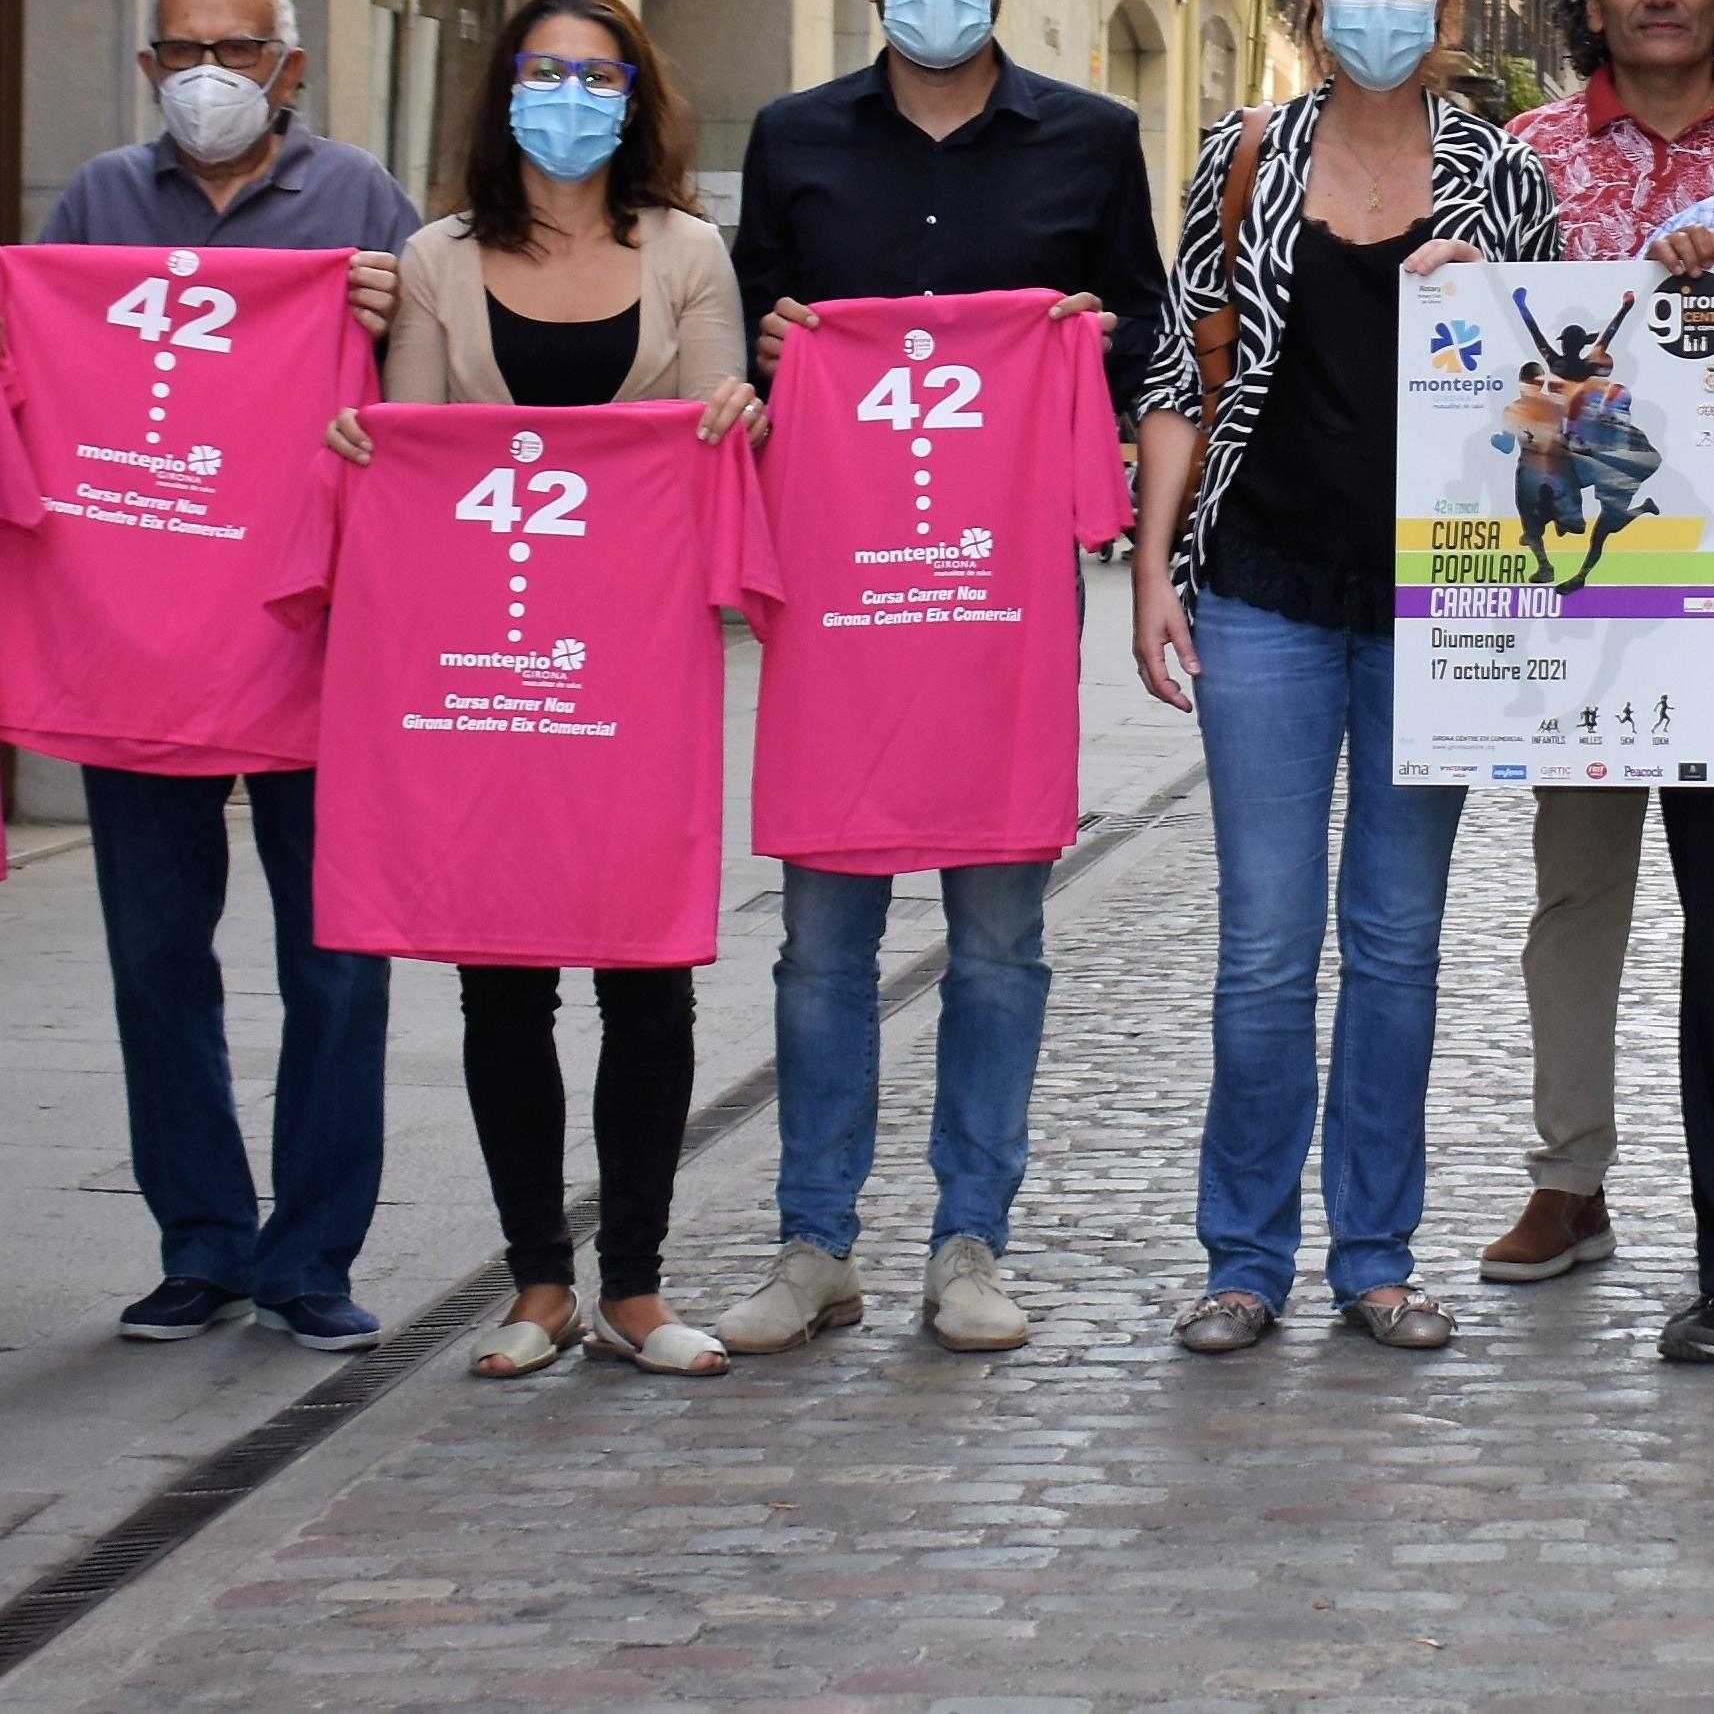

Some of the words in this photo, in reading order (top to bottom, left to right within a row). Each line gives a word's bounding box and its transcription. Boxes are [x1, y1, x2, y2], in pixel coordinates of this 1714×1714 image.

[106, 276, 238, 354] 42
[857, 364, 984, 431] 42
[1408, 375, 1505, 396] montepio
[76, 444, 187, 473] montepio
[76, 483, 122, 504] Cursa
[124, 491, 175, 511] Carrer
[175, 498, 208, 516] Nou
[455, 467, 588, 537] 42
[86, 505, 138, 526] Centre
[139, 513, 166, 530] Eix
[167, 517, 246, 540] Comercial
[1431, 520, 1501, 550] CURSA
[855, 542, 960, 564] montepio
[933, 560, 977, 569] GIRONA
[1431, 554, 1527, 584] POPULAR
[861, 590, 904, 605] Cursa
[907, 587, 955, 603] Carrer
[957, 585, 988, 601] Nou
[1430, 587, 1513, 618] CARRER
[1517, 587, 1562, 618] NOU
[822, 612, 871, 628] Girona
[874, 610, 923, 626] Centre
[925, 607, 951, 622] Eix
[952, 606, 1022, 622] Comercial
[1431, 627, 1516, 654] Diumenge
[439, 651, 551, 673] montepio
[1431, 659, 1448, 680] 17
[1453, 660, 1521, 680] octubre
[1526, 659, 1568, 680] 2021
[444, 693, 490, 710] Cursa
[492, 694, 543, 712] Carrer
[543, 696, 576, 714] Nou
[402, 713, 454, 731] Girona
[456, 715, 509, 732] Centre
[510, 716, 536, 733] Eix
[538, 718, 617, 737] Comercial
[1398, 760, 1430, 776] alma
[1623, 765, 1664, 778] Peacock
